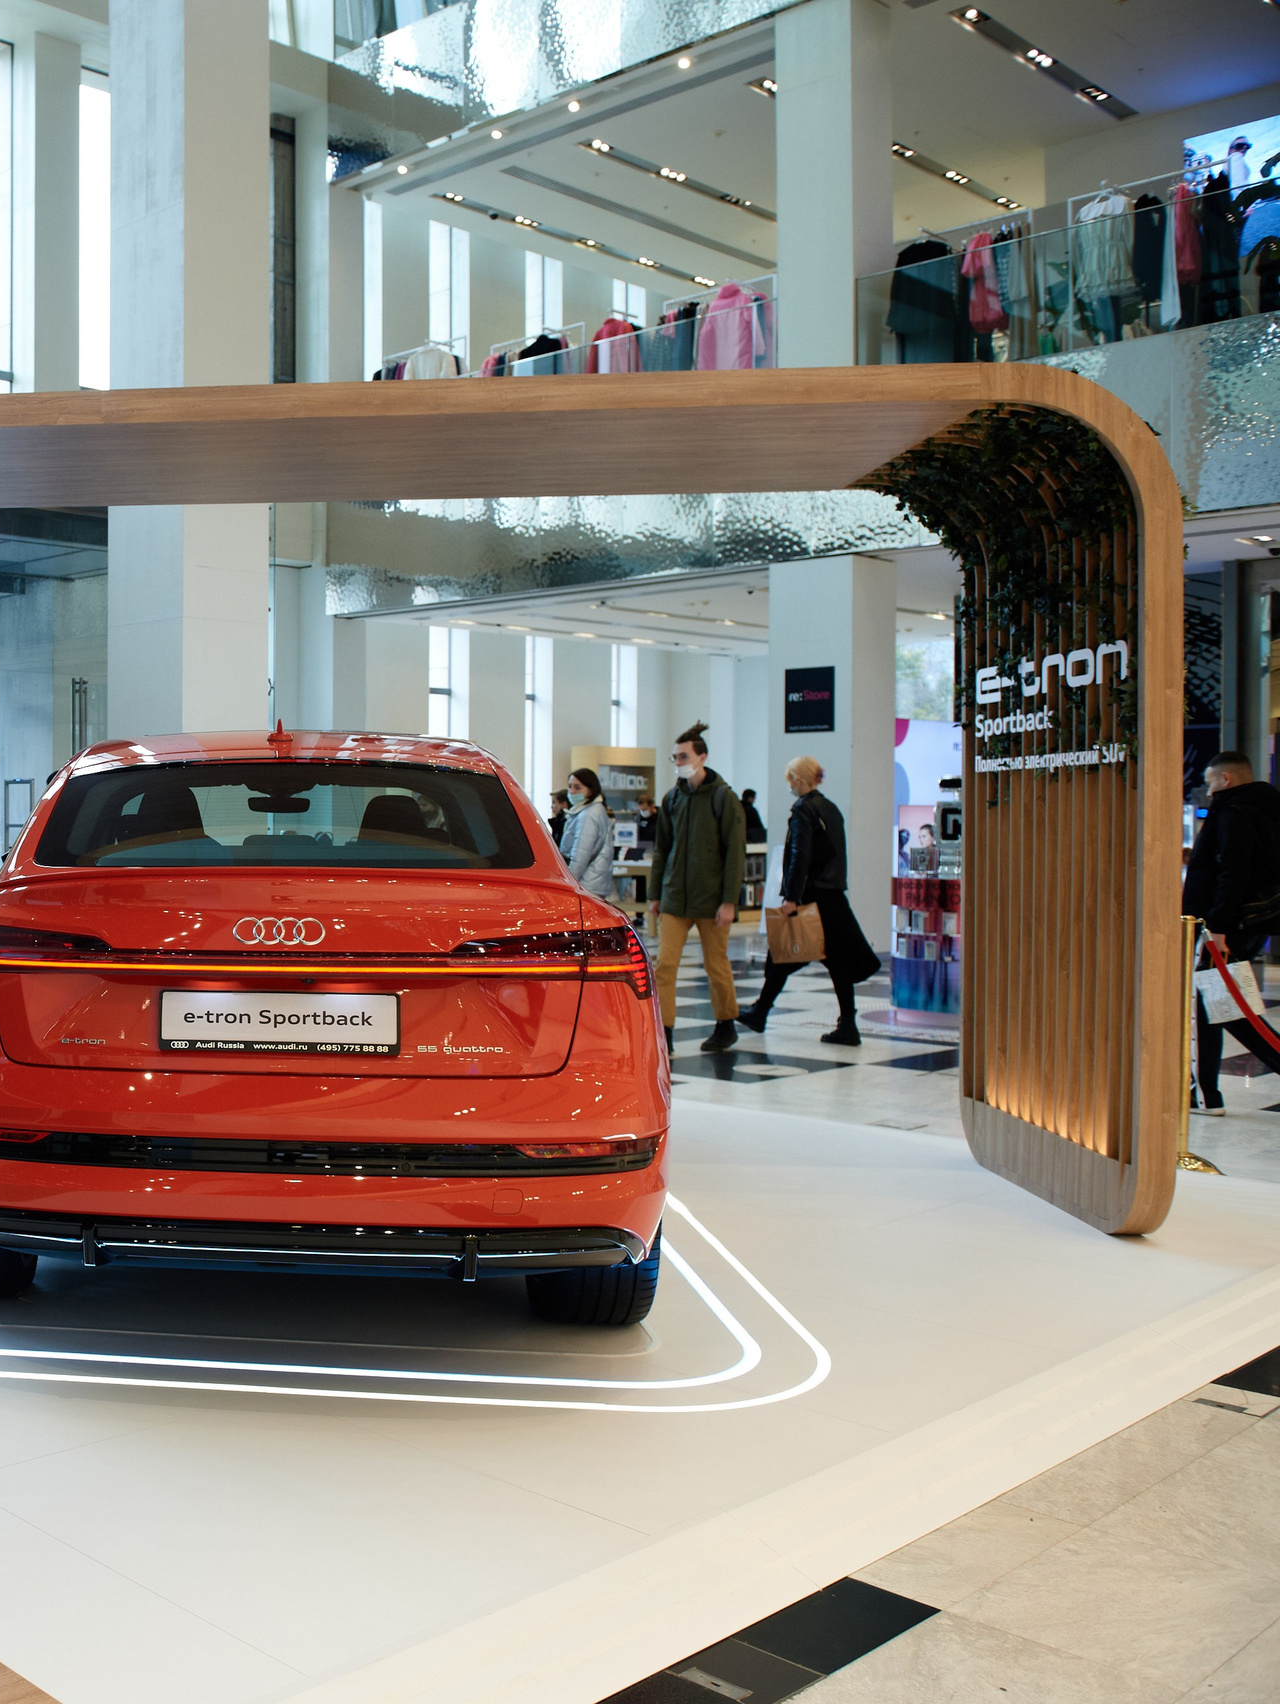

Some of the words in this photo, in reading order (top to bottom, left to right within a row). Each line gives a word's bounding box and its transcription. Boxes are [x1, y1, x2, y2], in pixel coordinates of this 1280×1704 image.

[975, 705, 1055, 742] Sportback
[183, 1009, 252, 1025] e-tron
[258, 1009, 373, 1028] Sportback
[61, 1037, 106, 1045] e-tron
[195, 1041, 215, 1049] Audi
[217, 1042, 245, 1050] Russia
[253, 1042, 308, 1051] www.audi.ru
[317, 1044, 341, 1052] (495)
[343, 1044, 362, 1052] 775
[363, 1045, 375, 1053] 88
[376, 1045, 389, 1053] 88
[417, 1045, 438, 1053] 55
[443, 1045, 504, 1054] quattro
